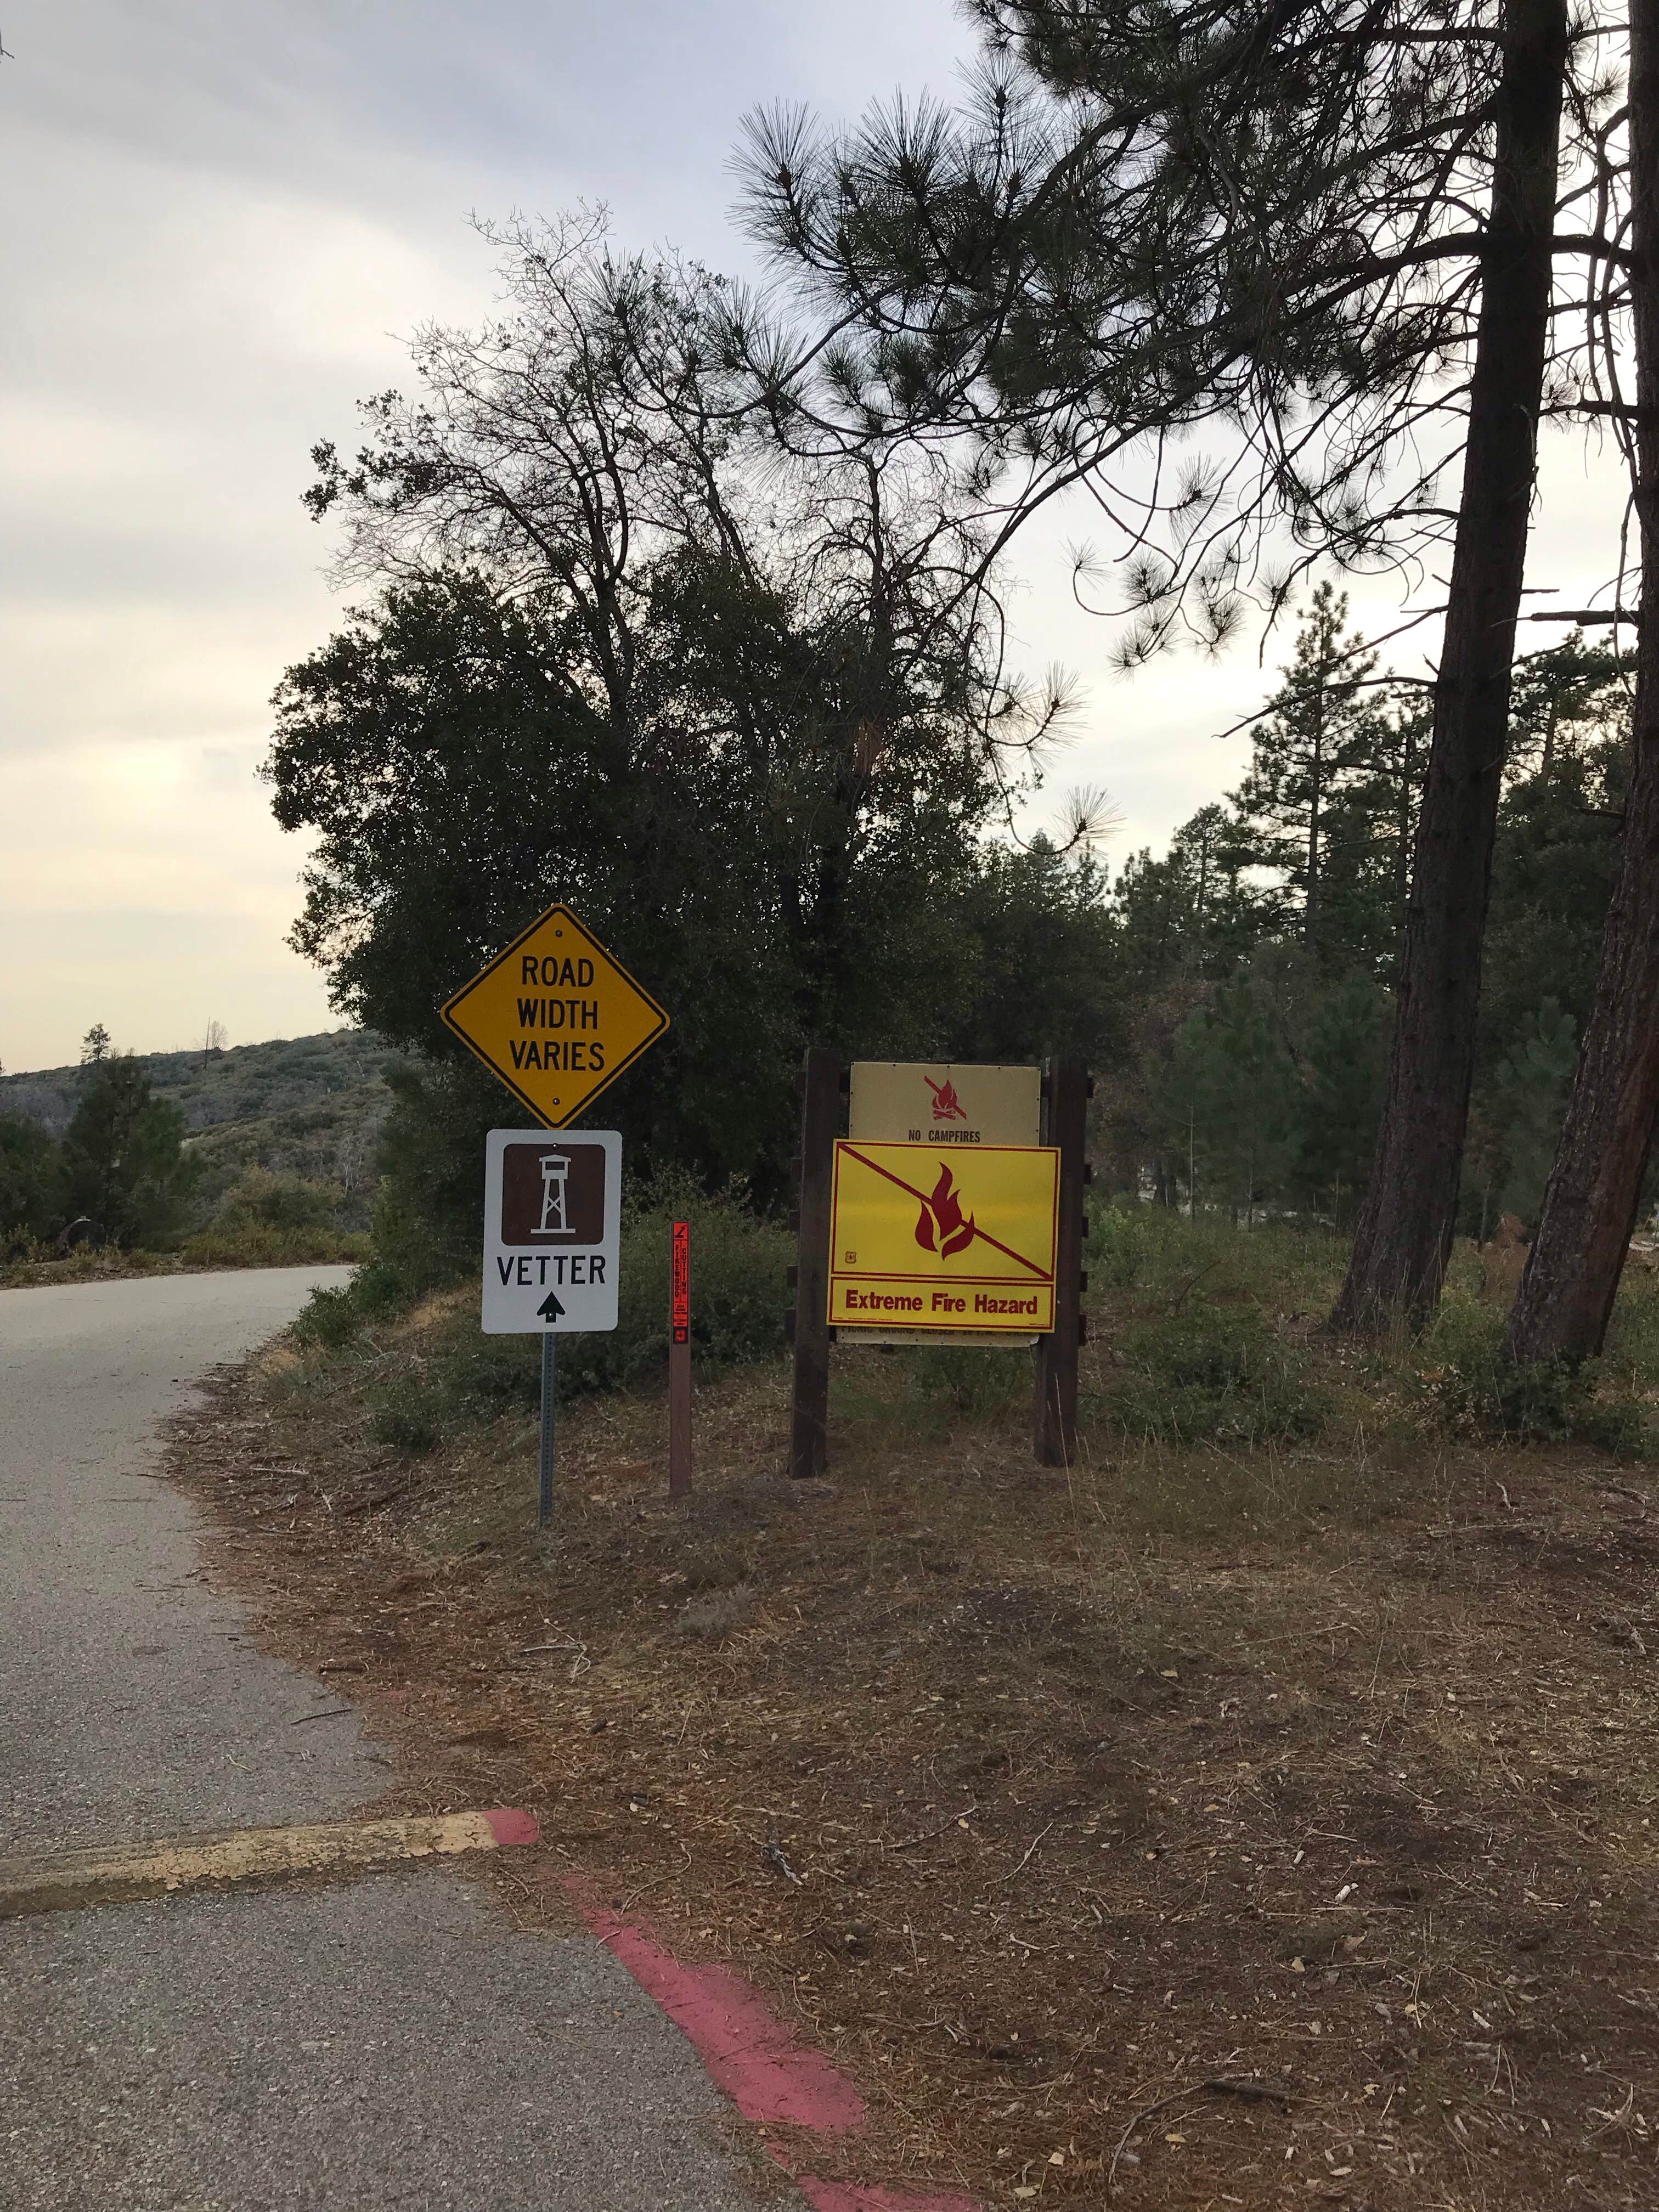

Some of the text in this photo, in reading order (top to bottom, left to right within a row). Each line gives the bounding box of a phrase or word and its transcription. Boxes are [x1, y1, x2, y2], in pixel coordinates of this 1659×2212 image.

[522, 956, 594, 987] ROAD
[517, 998, 598, 1030] WIDTH
[509, 1040, 605, 1071] VARIES
[909, 1130, 980, 1143] NO CAMPFIRES
[497, 1255, 606, 1285] VETTER
[846, 1289, 1037, 1314] Extreme Fire Hazard
